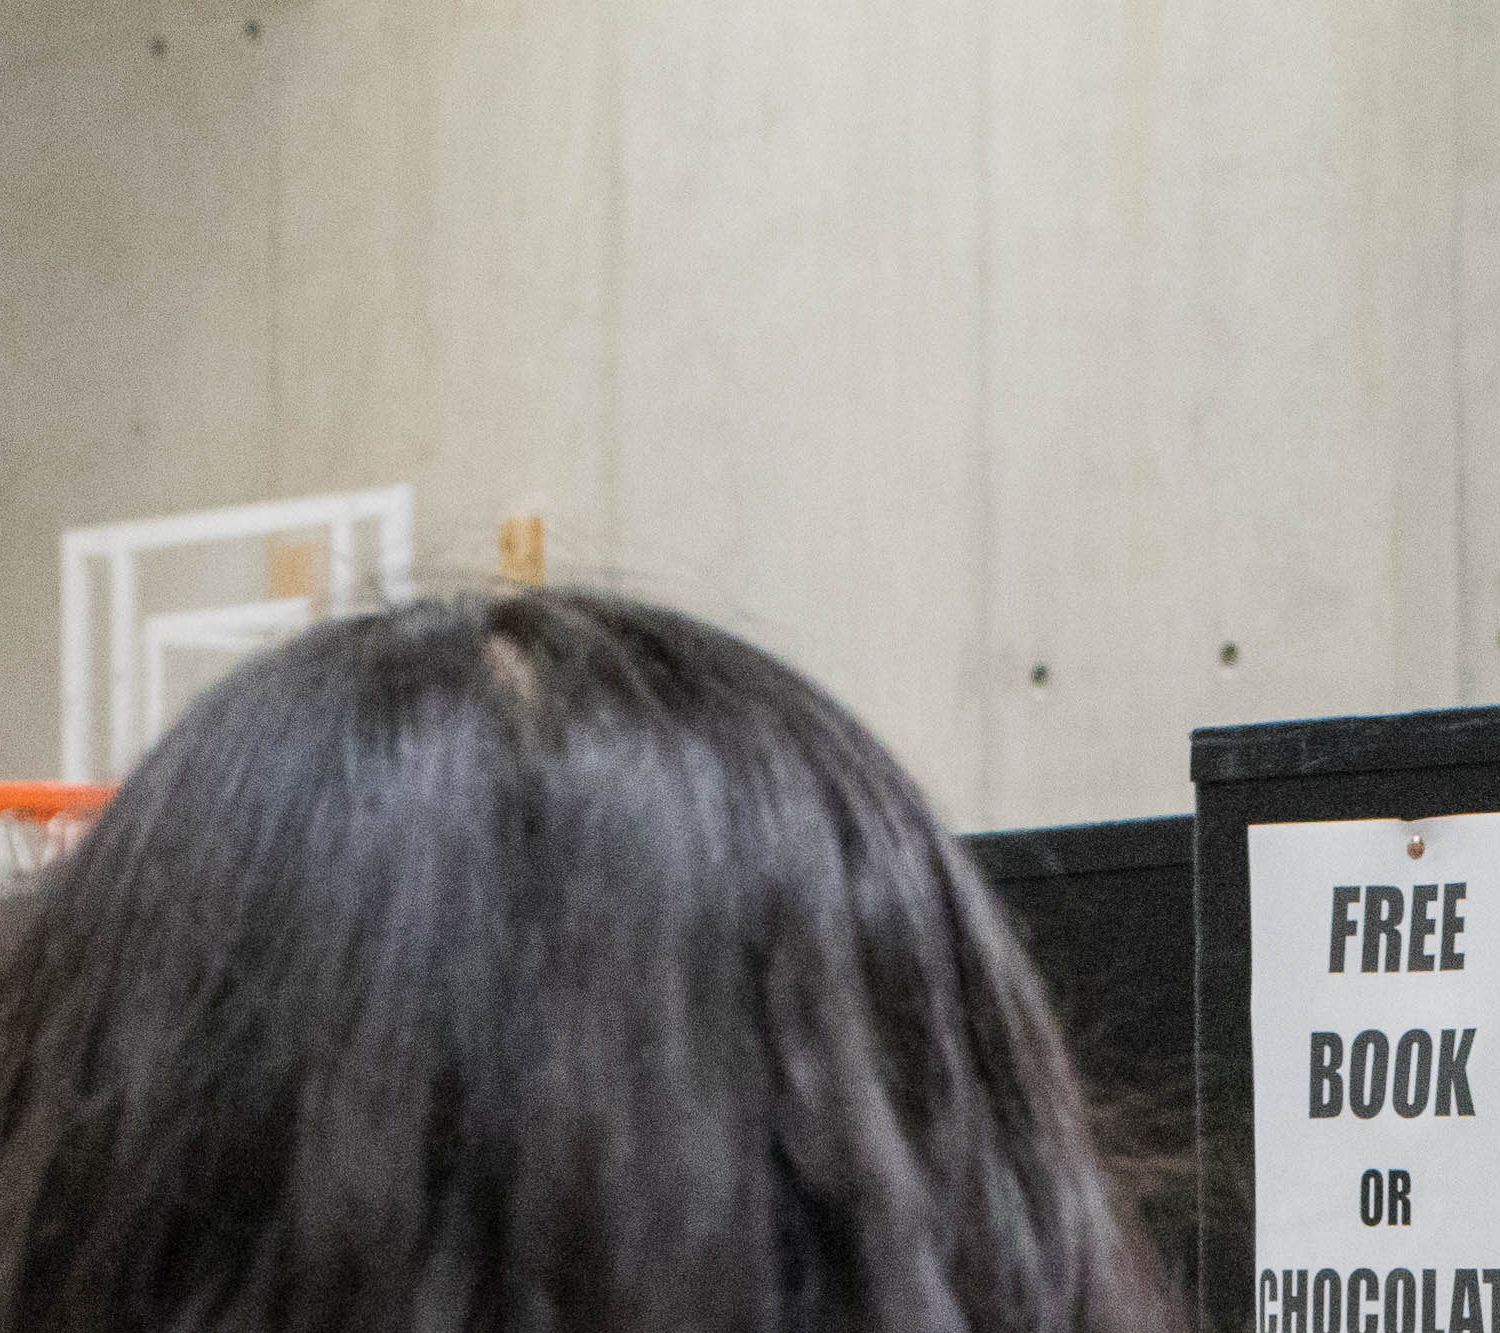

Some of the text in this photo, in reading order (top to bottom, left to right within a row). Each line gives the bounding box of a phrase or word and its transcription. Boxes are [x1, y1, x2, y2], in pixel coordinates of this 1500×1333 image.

[1328, 882, 1467, 973] FREE
[1309, 1028, 1477, 1120] BOOK
[1360, 1169, 1412, 1226] OR
